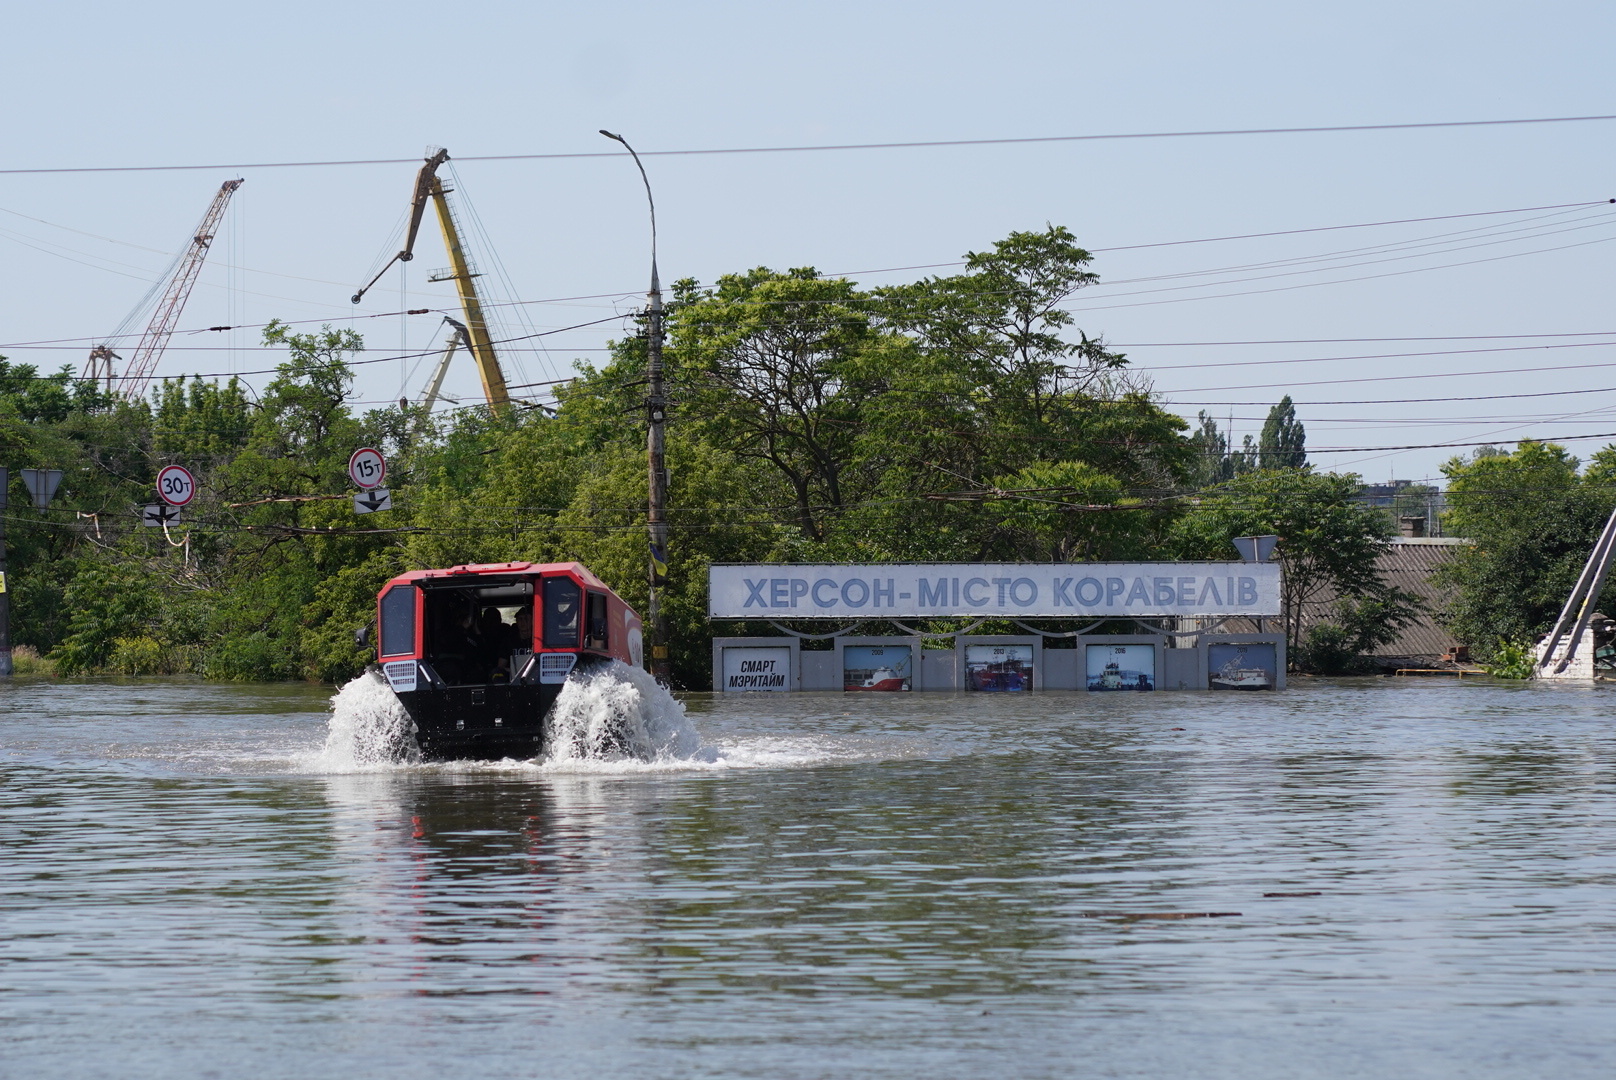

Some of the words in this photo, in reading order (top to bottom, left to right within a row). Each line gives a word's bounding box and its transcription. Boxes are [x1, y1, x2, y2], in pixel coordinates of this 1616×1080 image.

[1053, 577, 1259, 607] КОРАБЕЛІВ
[740, 660, 776, 673] СМАРТ
[729, 672, 785, 688] МЭРИТАЙМ
